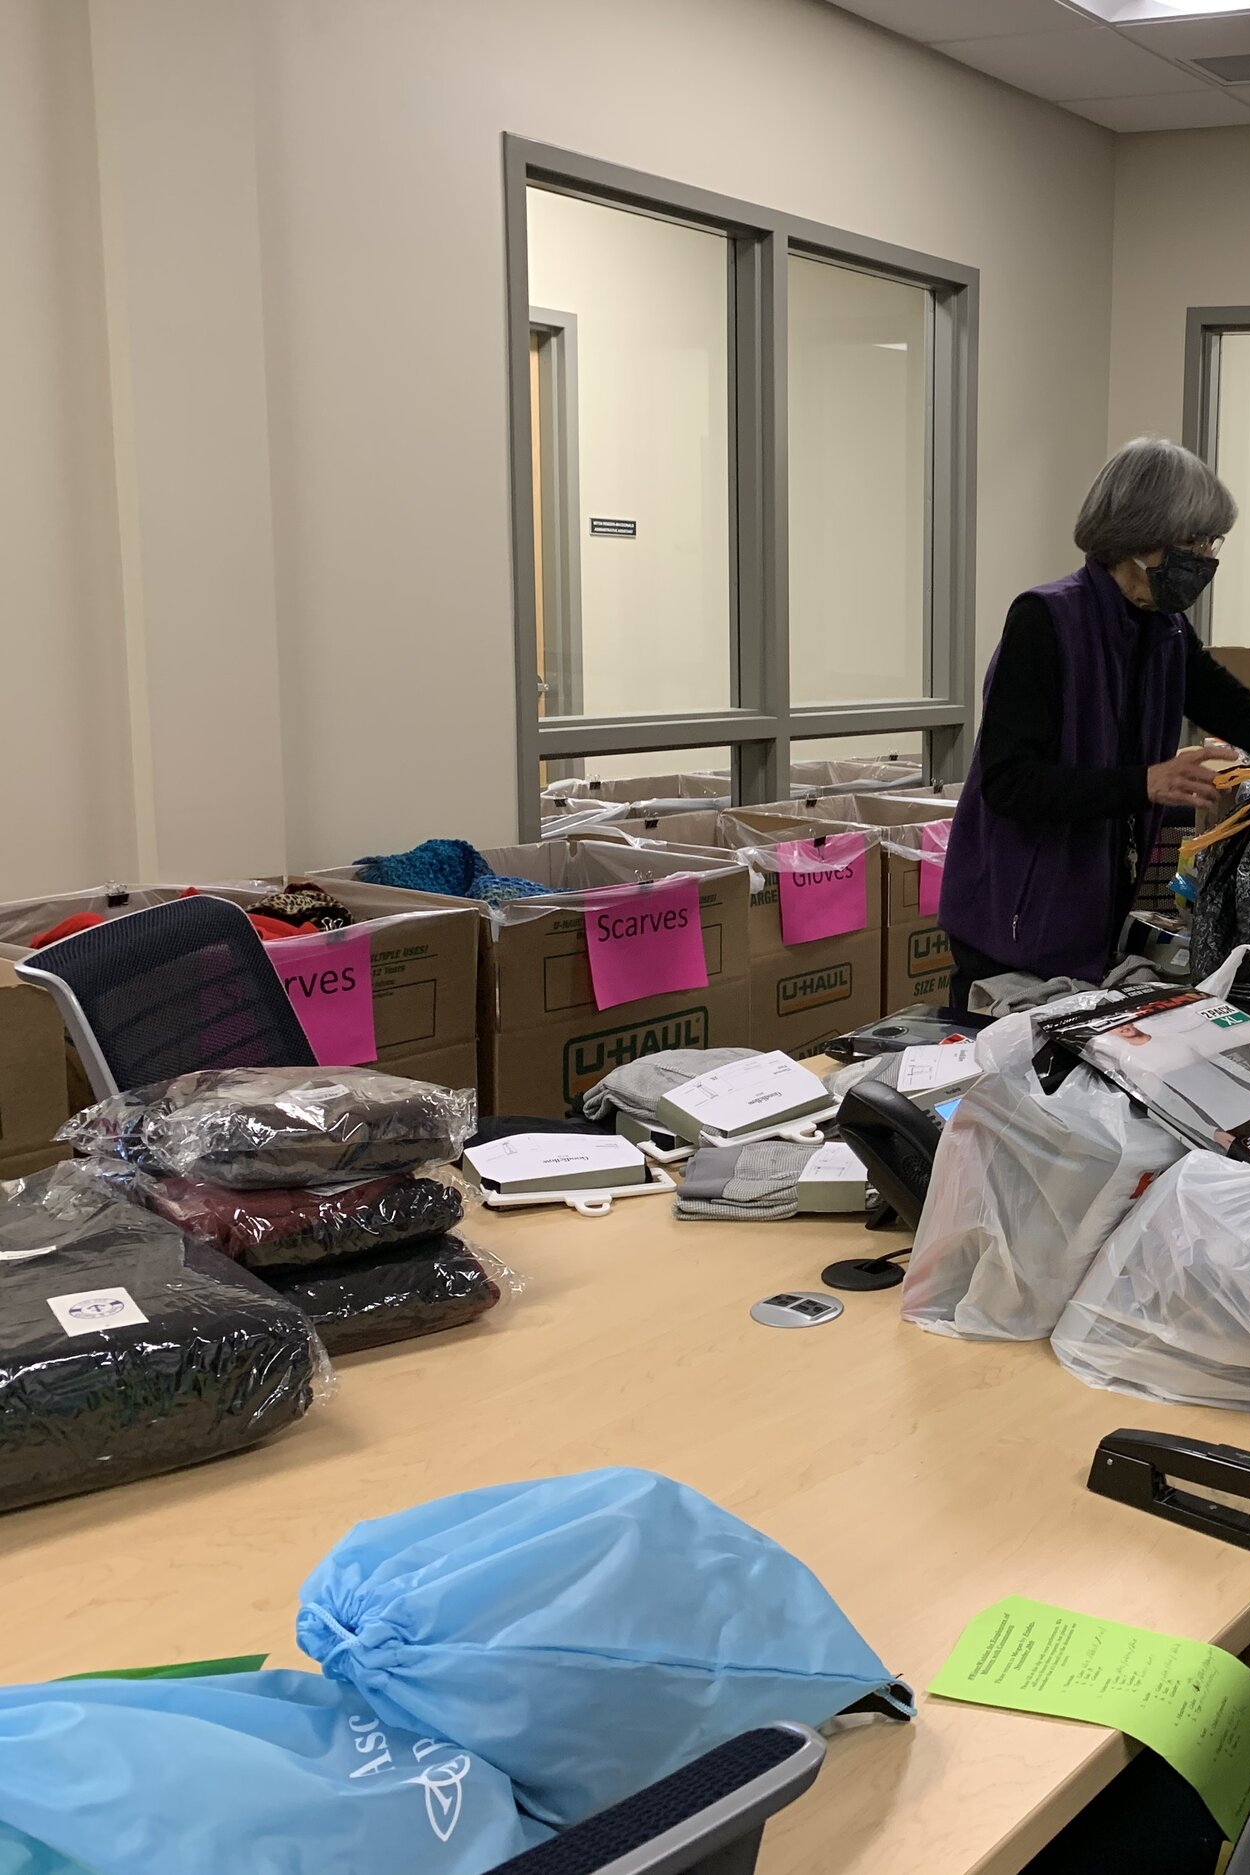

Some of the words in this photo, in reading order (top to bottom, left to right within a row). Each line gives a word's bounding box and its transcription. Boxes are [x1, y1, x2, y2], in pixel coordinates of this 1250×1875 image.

[793, 862, 853, 888] Gloves
[597, 906, 688, 942] Scarves
[782, 970, 848, 1001] U-HAUL
[914, 982, 935, 997] SIZE
[1221, 1014, 1243, 1026] XL
[575, 1019, 700, 1076] U-HAUL
